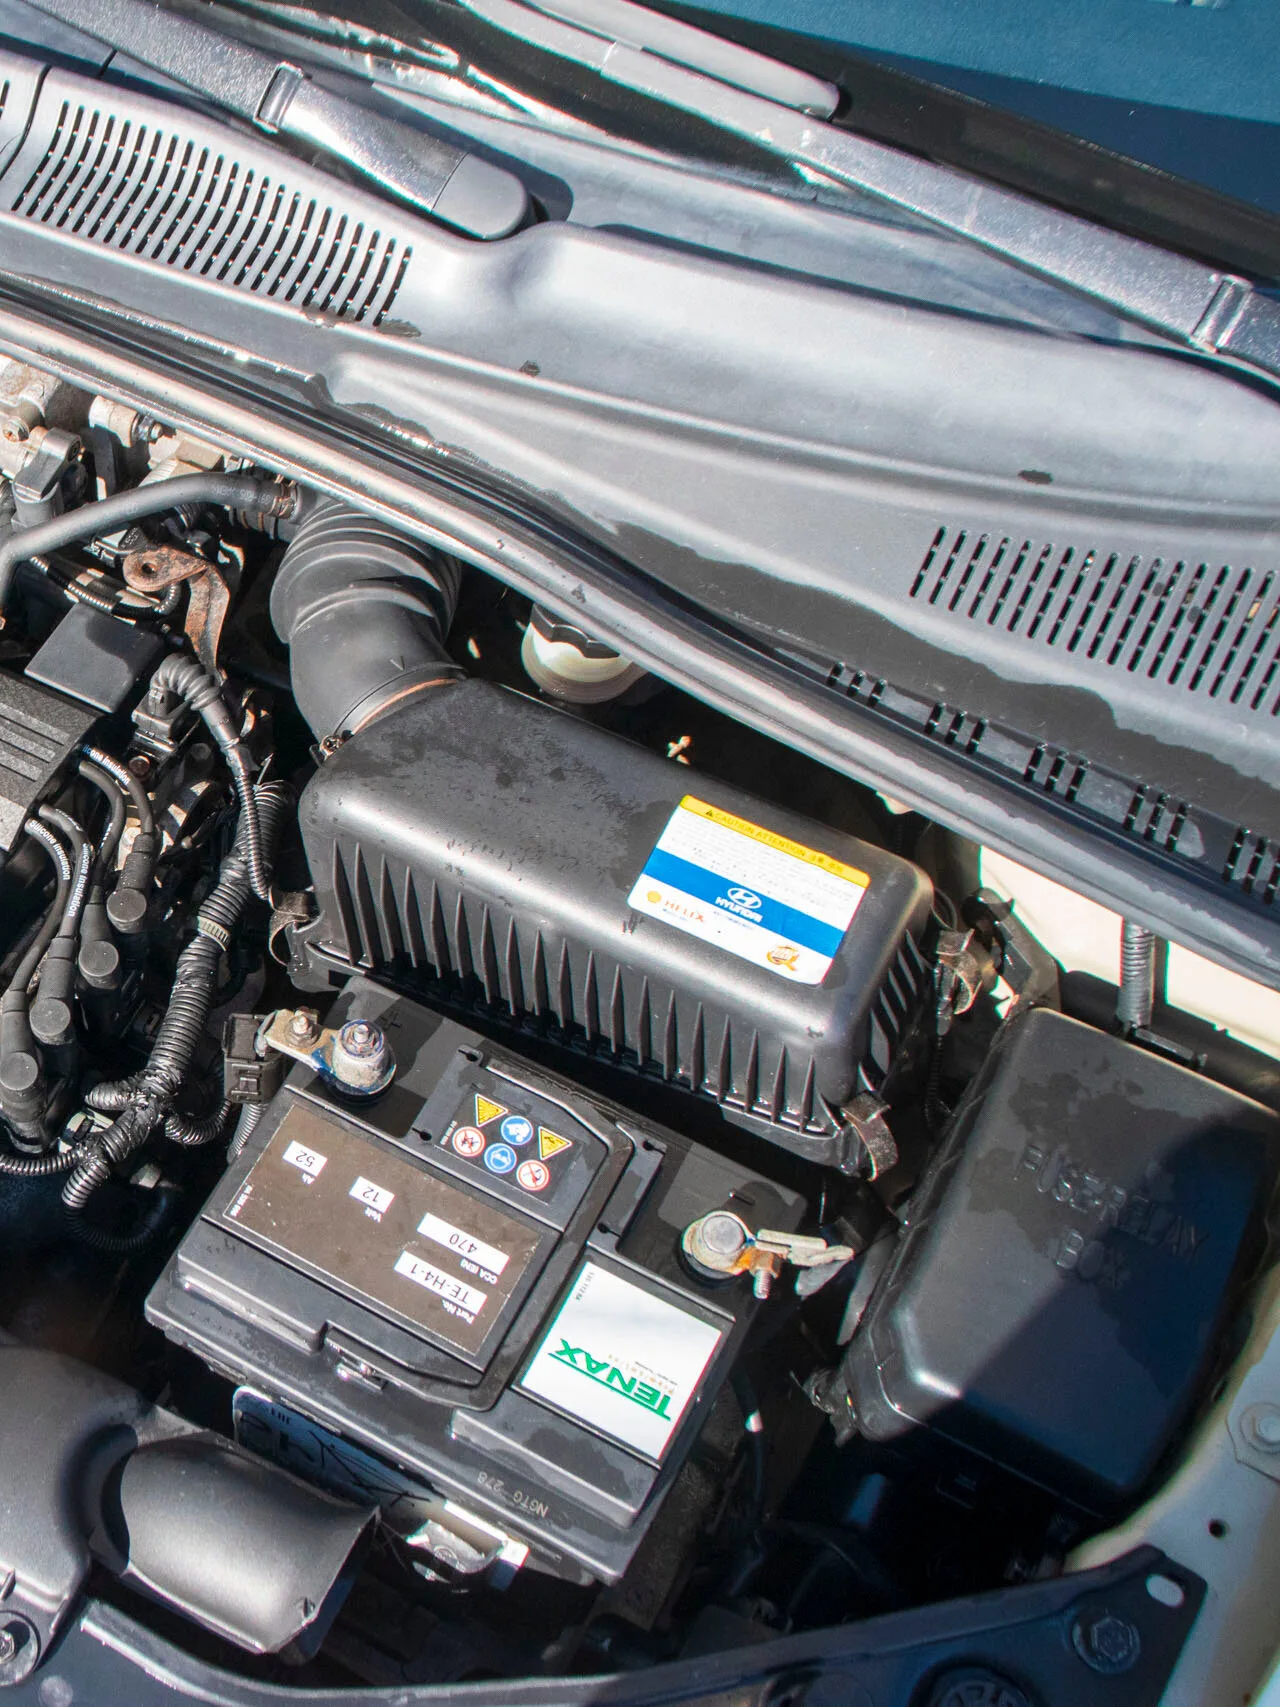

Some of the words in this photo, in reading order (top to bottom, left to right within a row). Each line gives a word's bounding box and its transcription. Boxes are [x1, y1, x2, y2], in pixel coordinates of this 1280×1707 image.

[714, 810, 755, 836] CAUTION
[756, 830, 807, 859] ATTENTION
[52, 842, 71, 881] insulation
[67, 873, 89, 918] insulation
[663, 899, 705, 924] HELIX
[715, 897, 763, 924] HYUNDAI
[293, 1149, 315, 1167] 52
[301, 1174, 317, 1186] Ah
[361, 1184, 383, 1202] 12
[364, 1207, 384, 1222] Volt
[447, 1231, 481, 1254] 470
[408, 1261, 473, 1306] TE-H4-1
[478, 1269, 498, 1284] CCA
[455, 1308, 475, 1324] Part
[547, 1337, 673, 1422] TENAX
